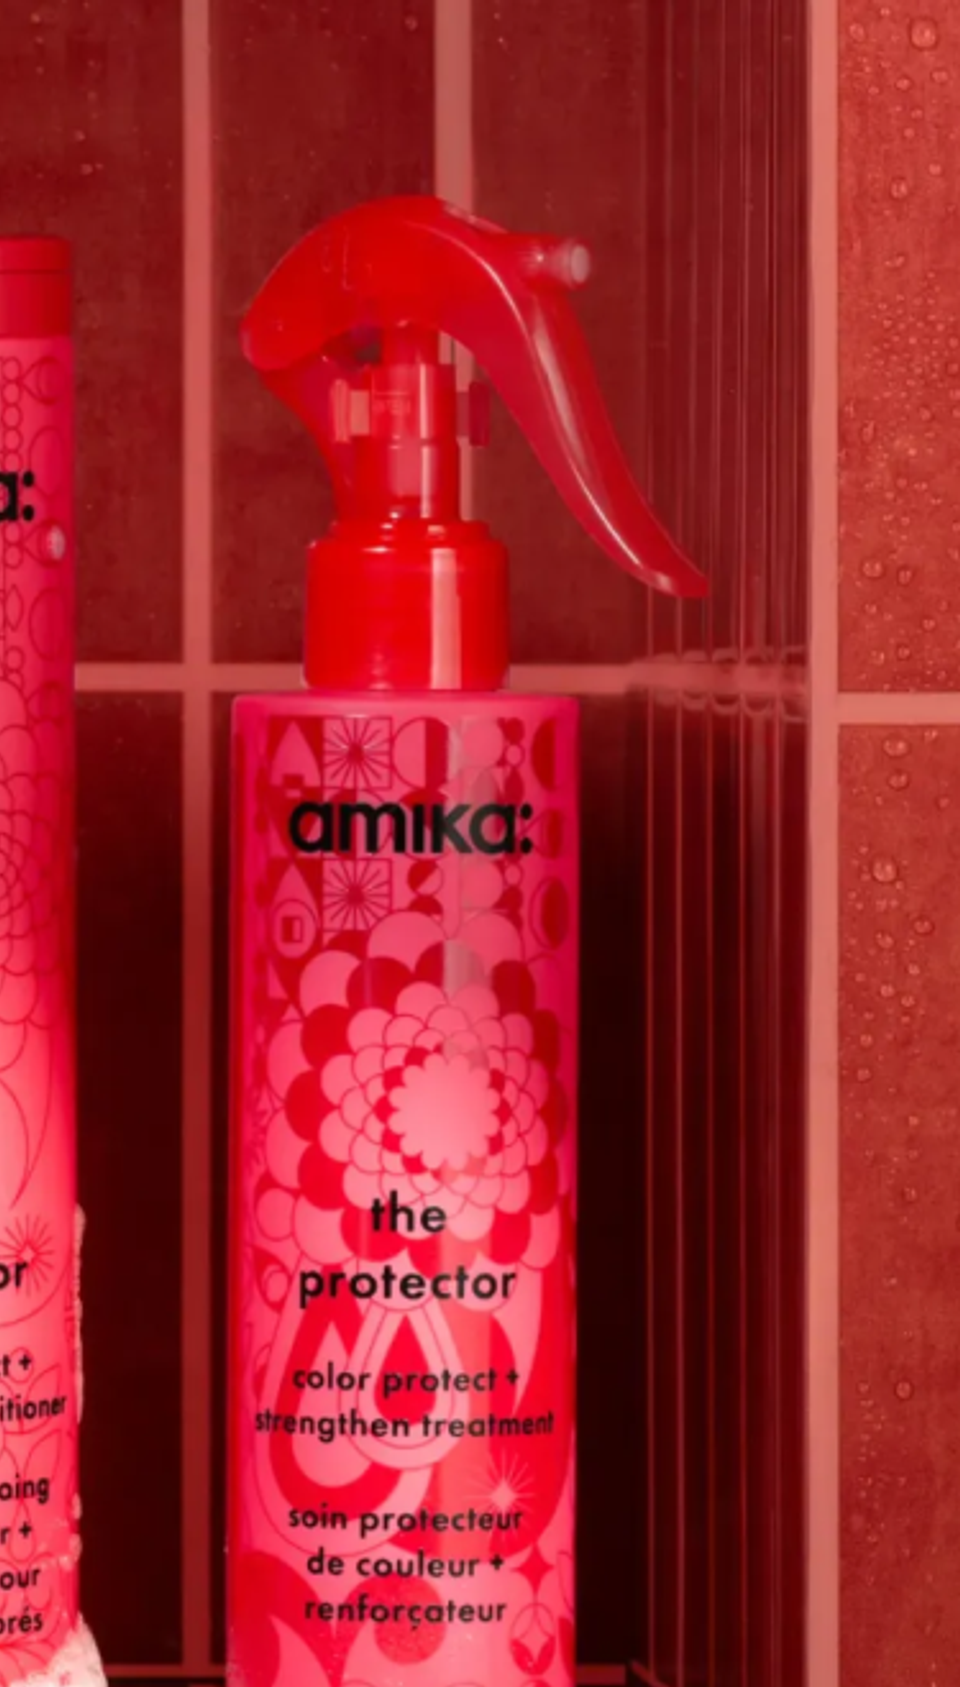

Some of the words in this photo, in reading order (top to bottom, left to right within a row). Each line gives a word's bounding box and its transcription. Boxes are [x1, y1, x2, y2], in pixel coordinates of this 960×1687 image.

[287, 800, 534, 855] amika:
[370, 1189, 447, 1234] the
[299, 1264, 517, 1310] protector
[291, 1361, 371, 1392] color
[382, 1367, 498, 1400] protect
[254, 1407, 410, 1445] strengthen
[421, 1410, 555, 1438] treatment
[288, 1501, 349, 1530] soin
[359, 1508, 523, 1540] protecteur
[306, 1546, 345, 1576] de
[355, 1548, 480, 1579] couleur
[304, 1592, 507, 1631] renforçateur
